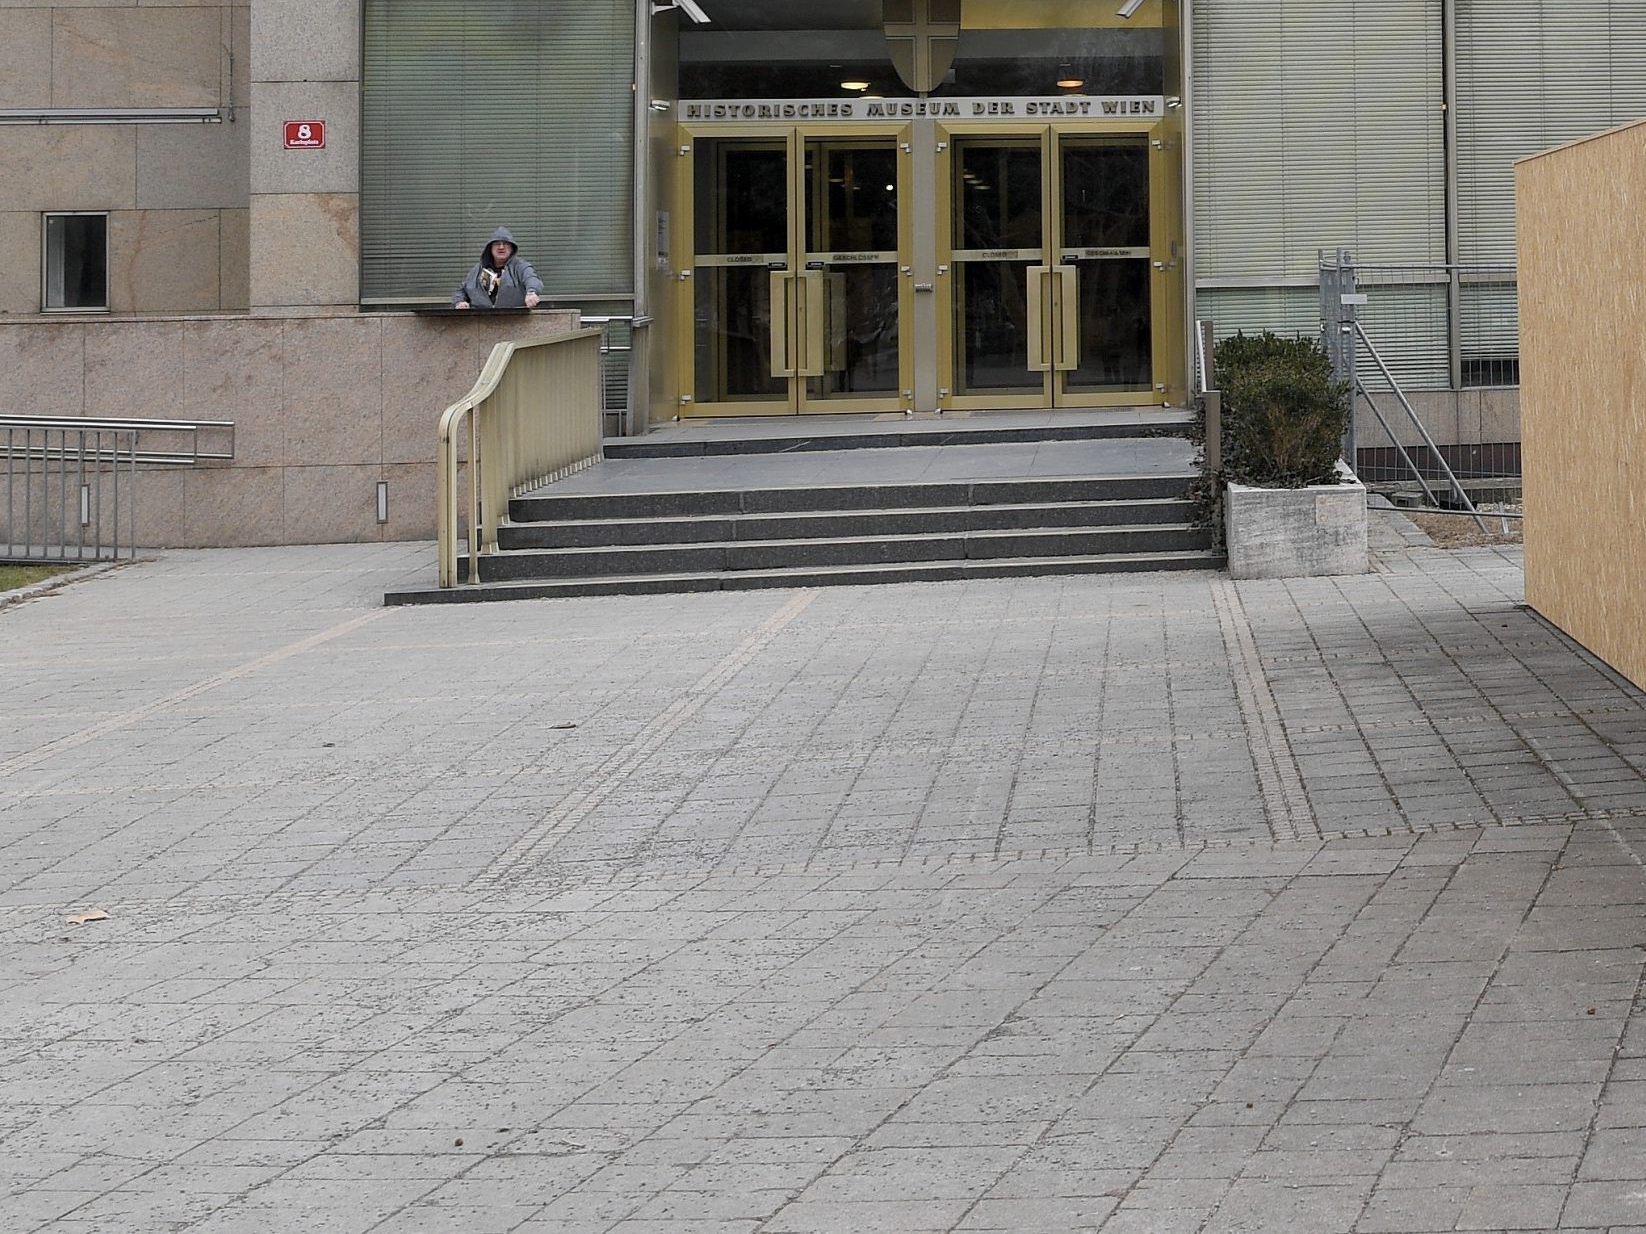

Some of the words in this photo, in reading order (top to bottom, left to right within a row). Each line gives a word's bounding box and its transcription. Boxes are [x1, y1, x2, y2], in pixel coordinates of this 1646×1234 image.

[687, 103, 853, 117] HISTORISCHES
[866, 102, 960, 116] MUSEUM
[972, 102, 1015, 115] DER
[1026, 101, 1092, 114] STADT
[1101, 100, 1155, 114] WIEN
[298, 124, 312, 139] 8
